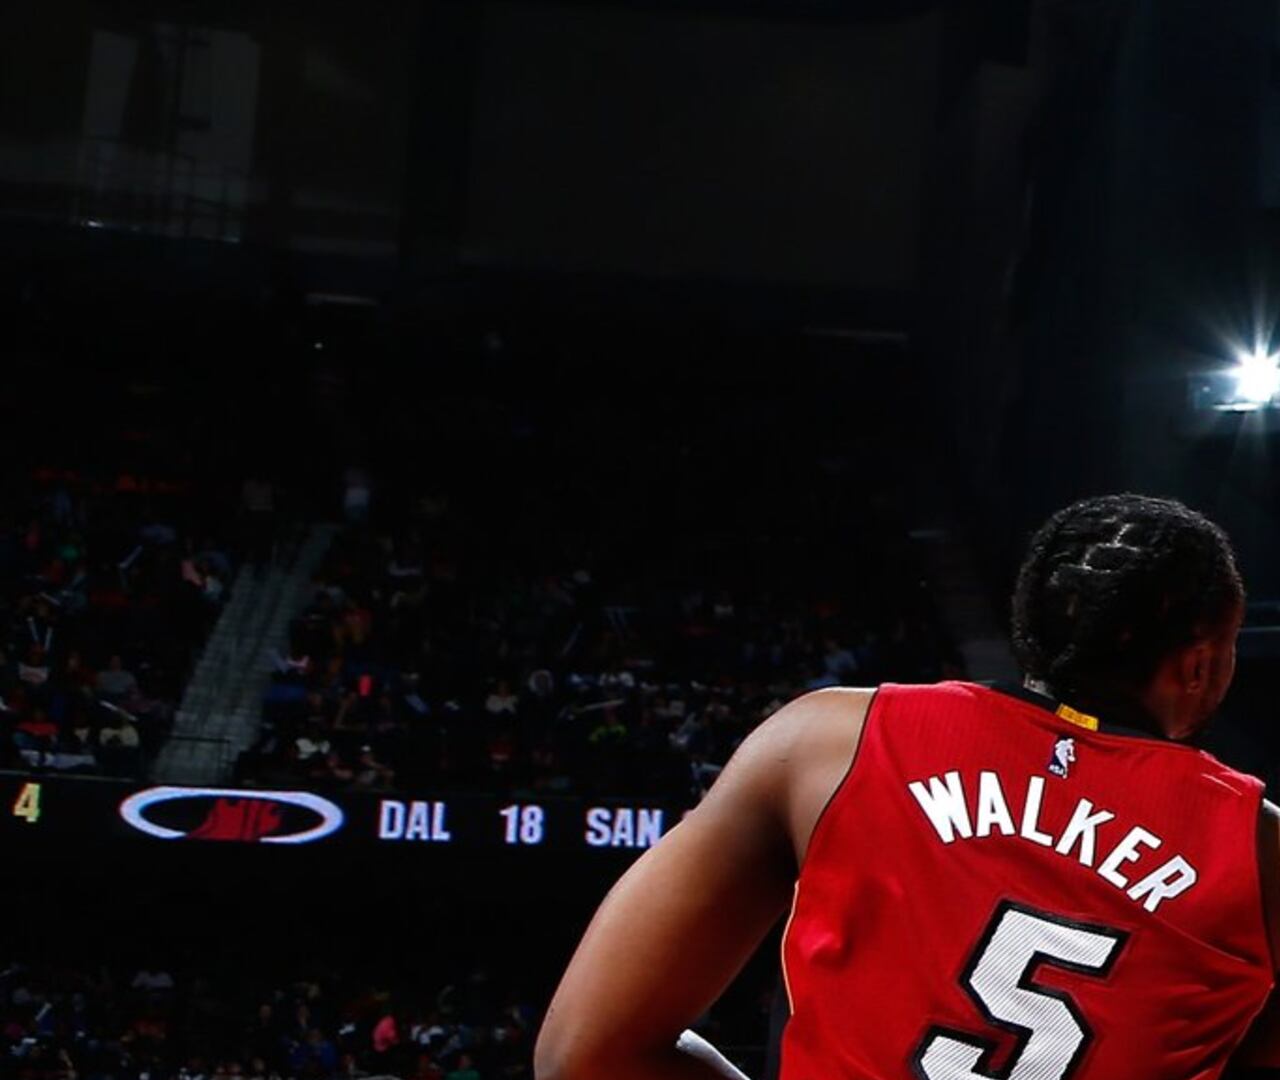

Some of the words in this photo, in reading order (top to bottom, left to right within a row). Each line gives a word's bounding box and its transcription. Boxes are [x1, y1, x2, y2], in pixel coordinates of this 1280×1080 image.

[13, 783, 41, 822] 4
[379, 800, 451, 841] DAL
[499, 805, 544, 843] 18
[586, 807, 664, 847] SAN
[908, 770, 1199, 913] WALKER
